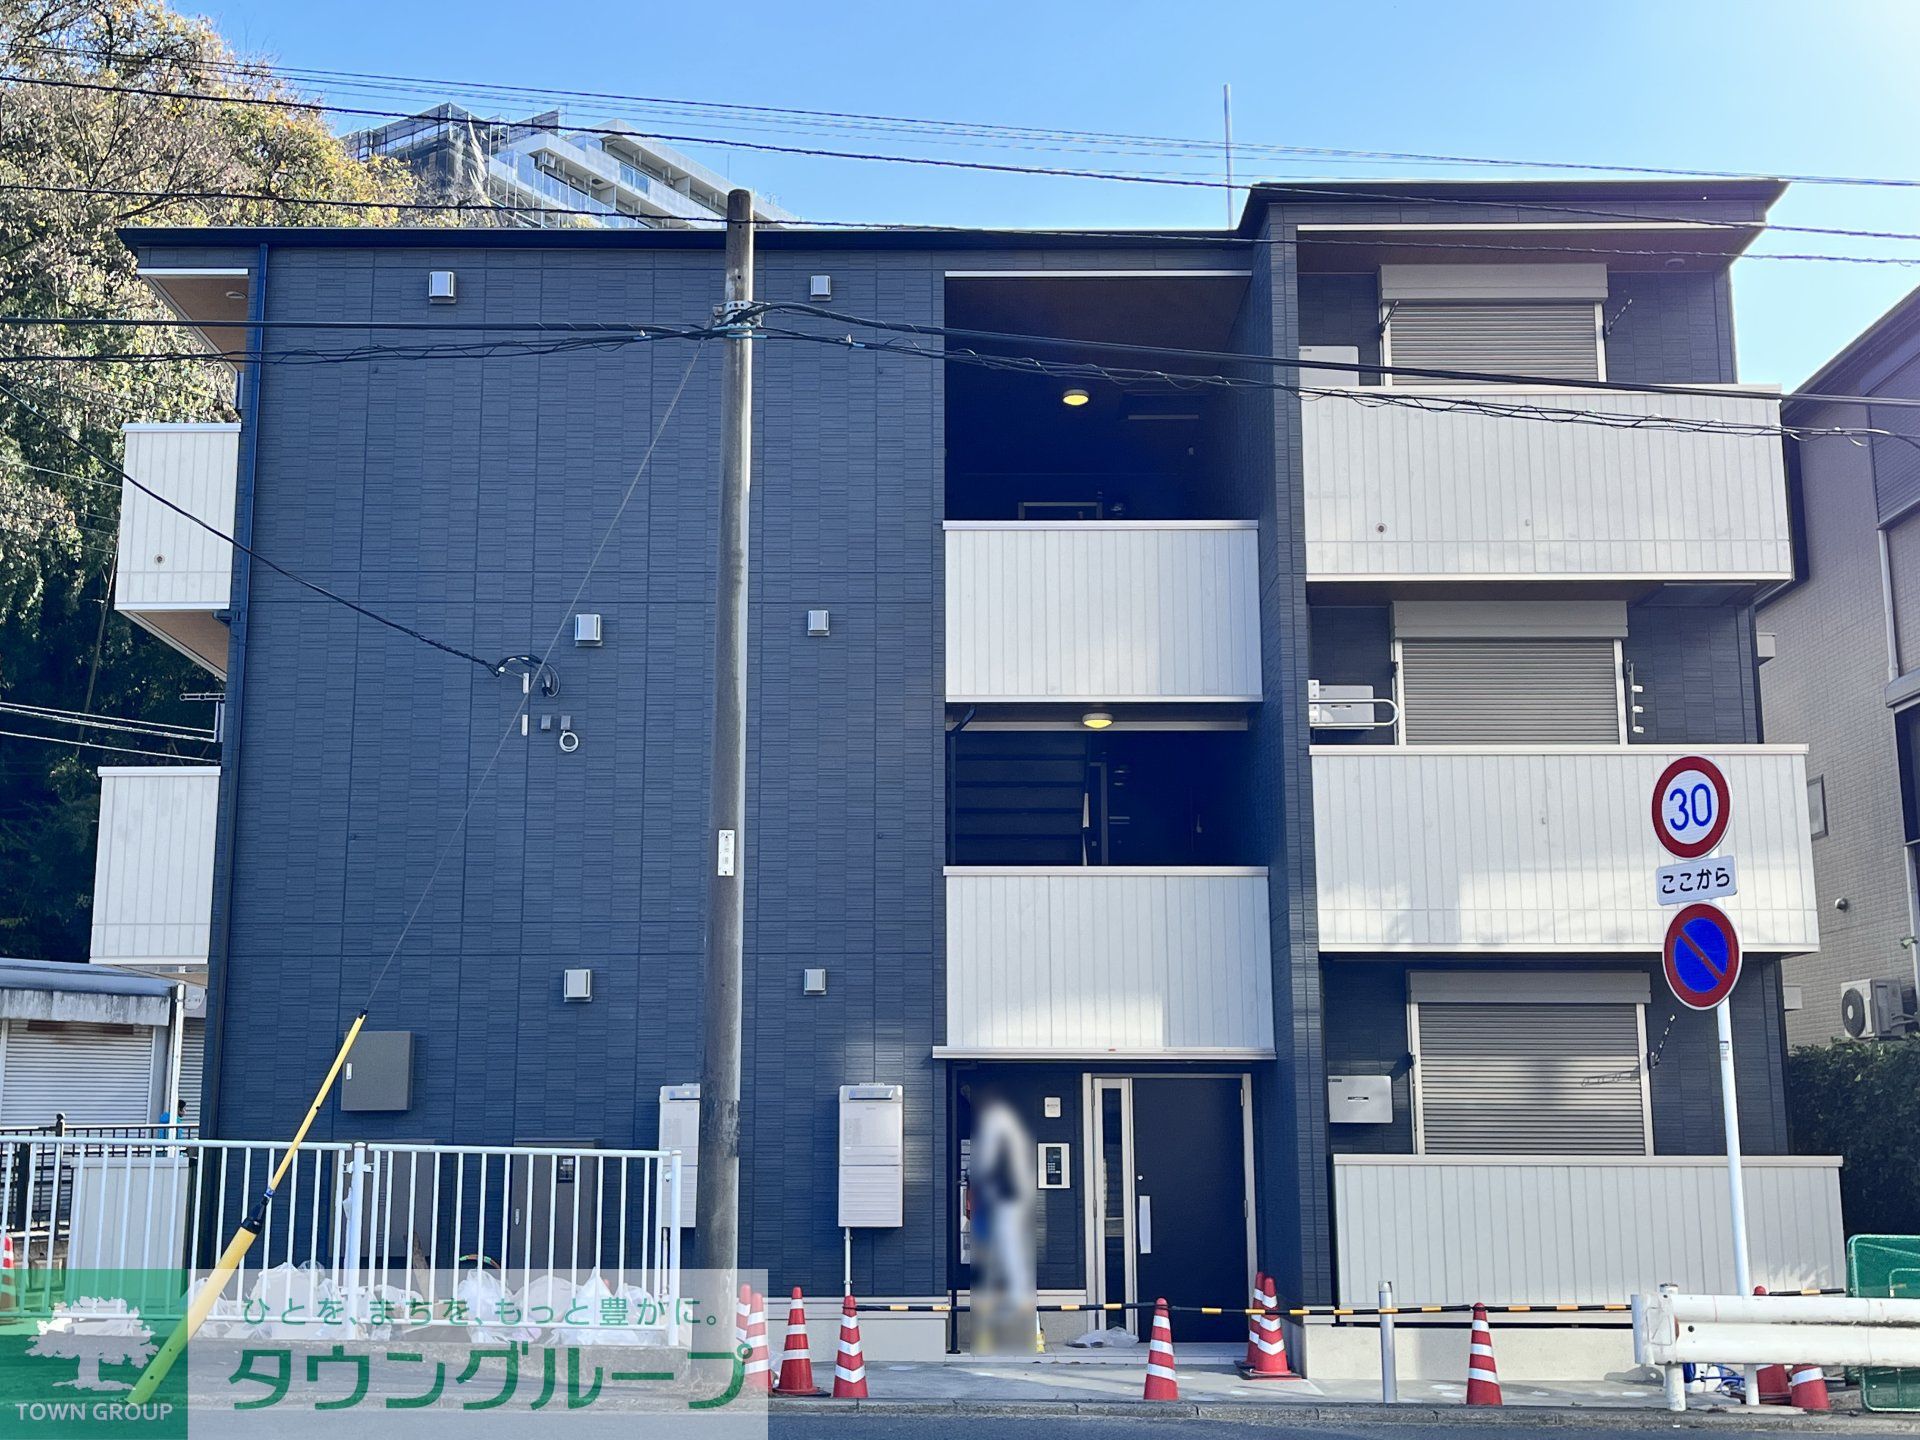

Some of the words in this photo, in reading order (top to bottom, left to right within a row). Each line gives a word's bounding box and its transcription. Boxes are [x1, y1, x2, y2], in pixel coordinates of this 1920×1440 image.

[1669, 783, 1712, 831] 30
[1661, 867, 1730, 894] ここから
